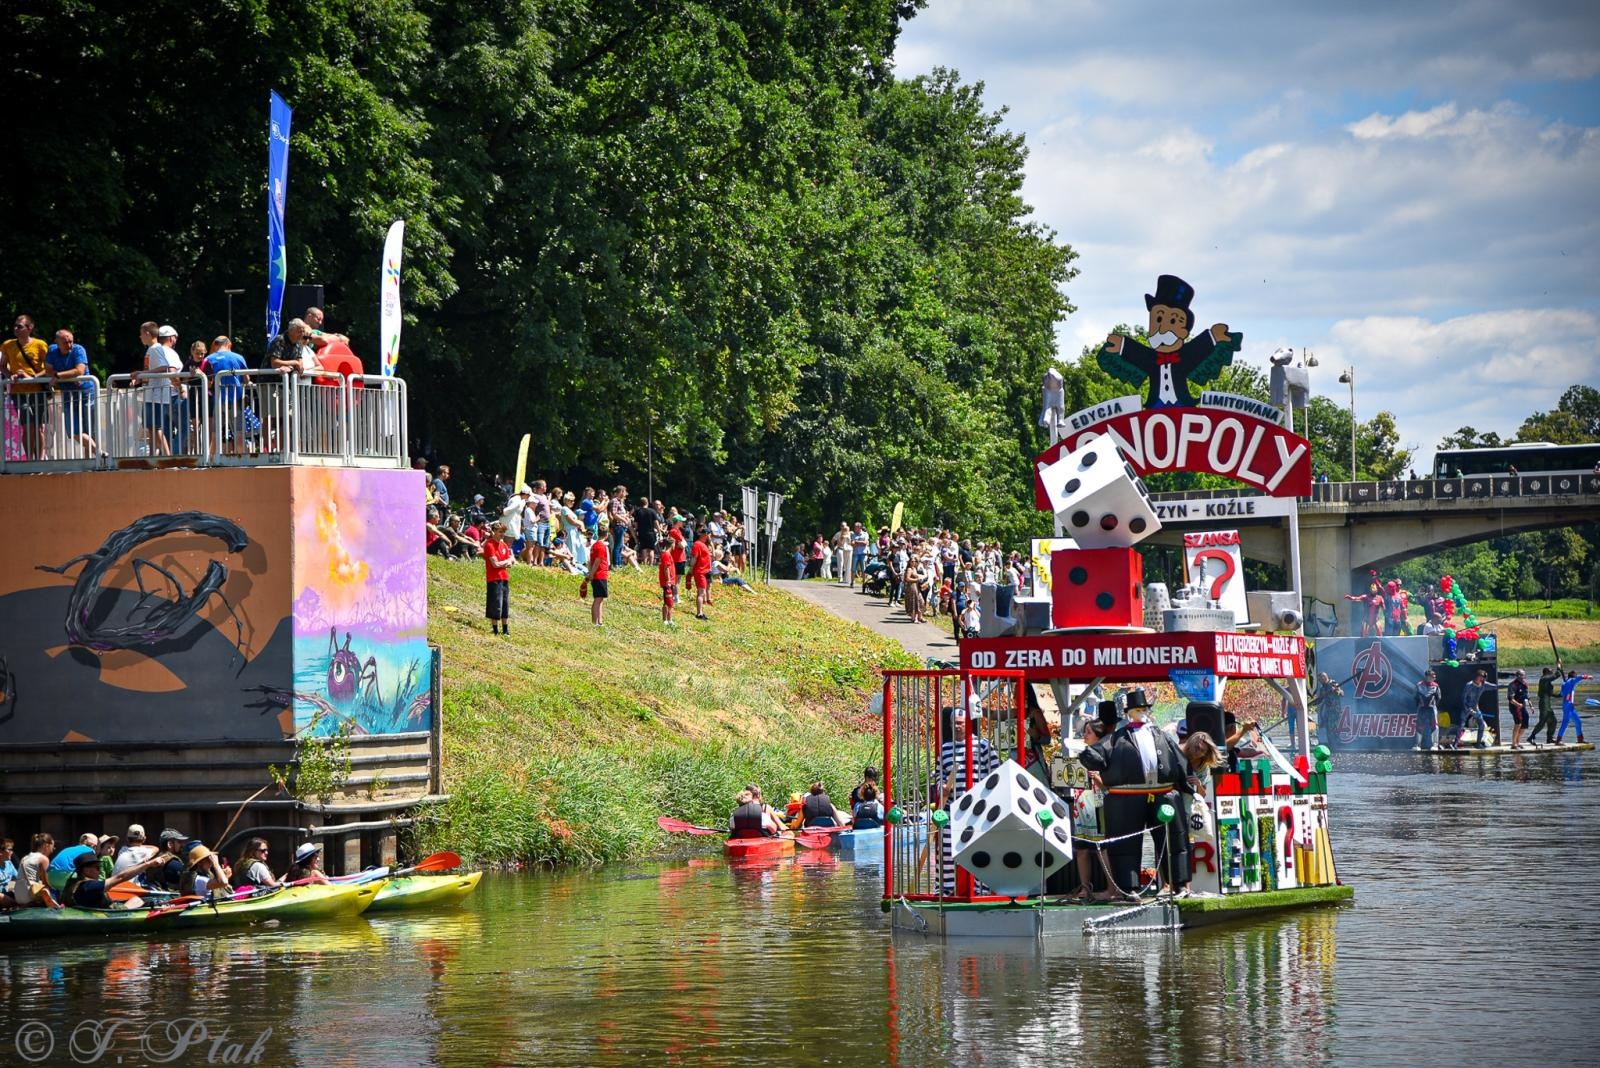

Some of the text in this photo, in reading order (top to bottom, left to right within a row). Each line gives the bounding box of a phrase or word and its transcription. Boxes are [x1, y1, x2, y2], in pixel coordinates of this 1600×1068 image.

[1071, 394, 1279, 429] EDYCJA LIMITOWANA
[1037, 412, 1306, 492] NOPOLY
[1206, 499, 1255, 517] KOŹLE
[1184, 532, 1241, 548] SZANSA
[971, 646, 1198, 668] OD ZERA DO MILIONERA
[1337, 705, 1417, 743] AVENGERS
